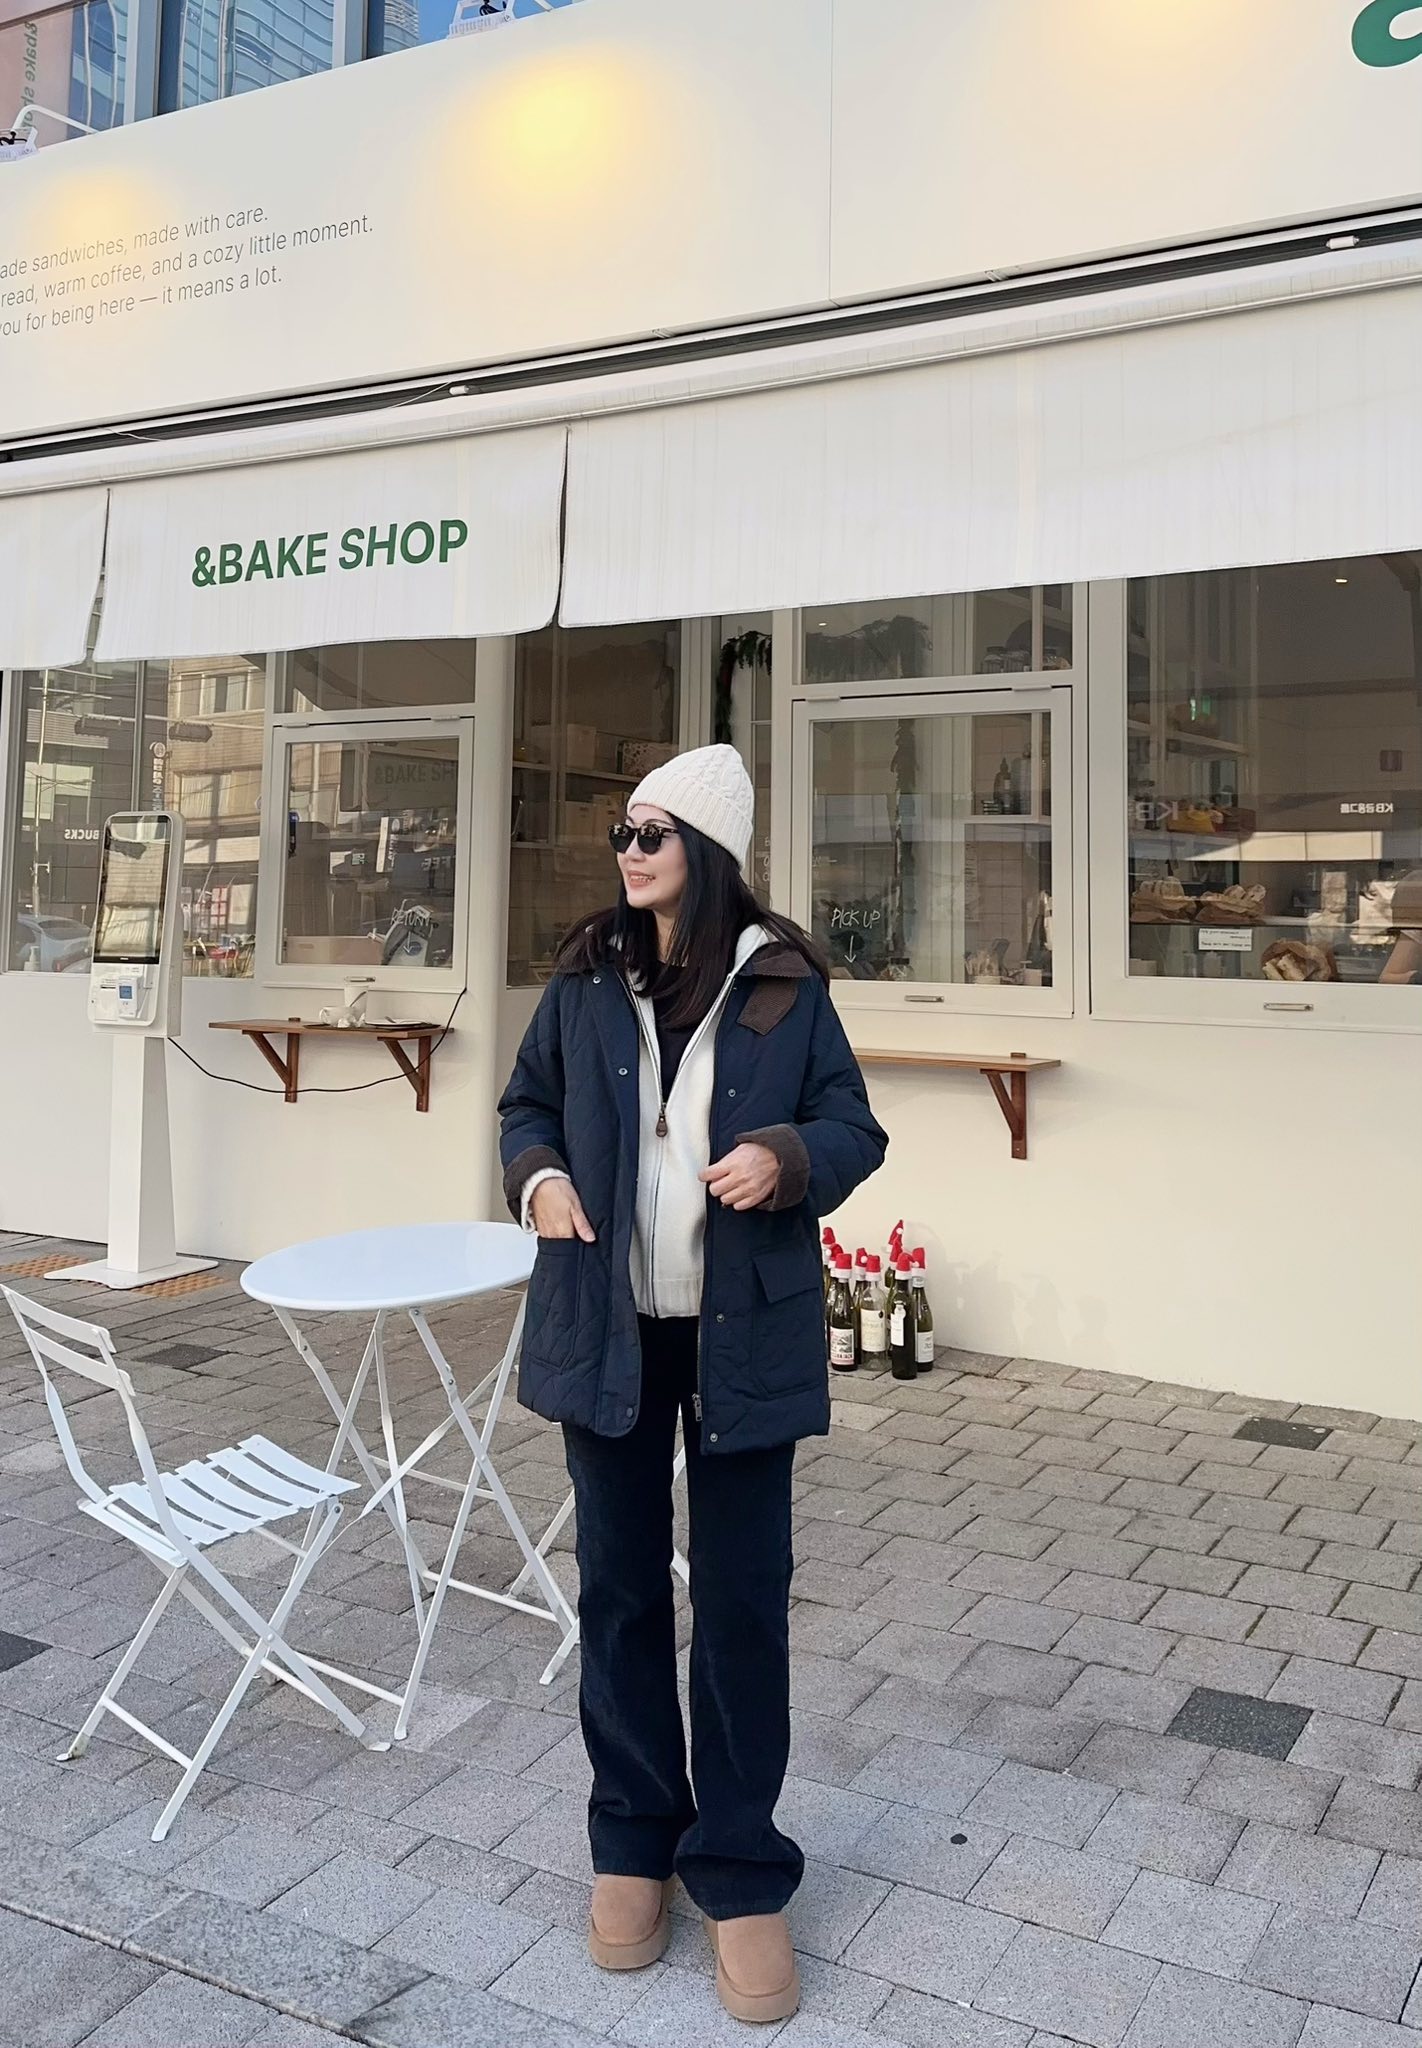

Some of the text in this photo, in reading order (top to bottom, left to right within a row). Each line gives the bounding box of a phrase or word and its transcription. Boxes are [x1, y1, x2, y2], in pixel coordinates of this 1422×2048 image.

[32, 241, 128, 272] sandwiches,
[134, 224, 179, 249] made
[185, 213, 220, 238] with
[226, 207, 268, 229] care.
[44, 276, 86, 298] warm
[90, 263, 146, 290] coffee,
[152, 252, 182, 276] and
[188, 253, 198, 268] a
[203, 243, 244, 264] cozy
[249, 232, 287, 256] little
[293, 214, 373, 247] moment.
[0, 318, 21, 337] ou
[26, 312, 47, 332] for
[52, 304, 94, 325] being
[99, 296, 135, 317] here
[162, 285, 173, 305] it
[178, 276, 234, 301] means
[240, 273, 249, 290] a
[255, 265, 282, 287] lot.
[191, 519, 468, 588] &BAKE SHOP
[831, 907, 881, 929] PICK UP
